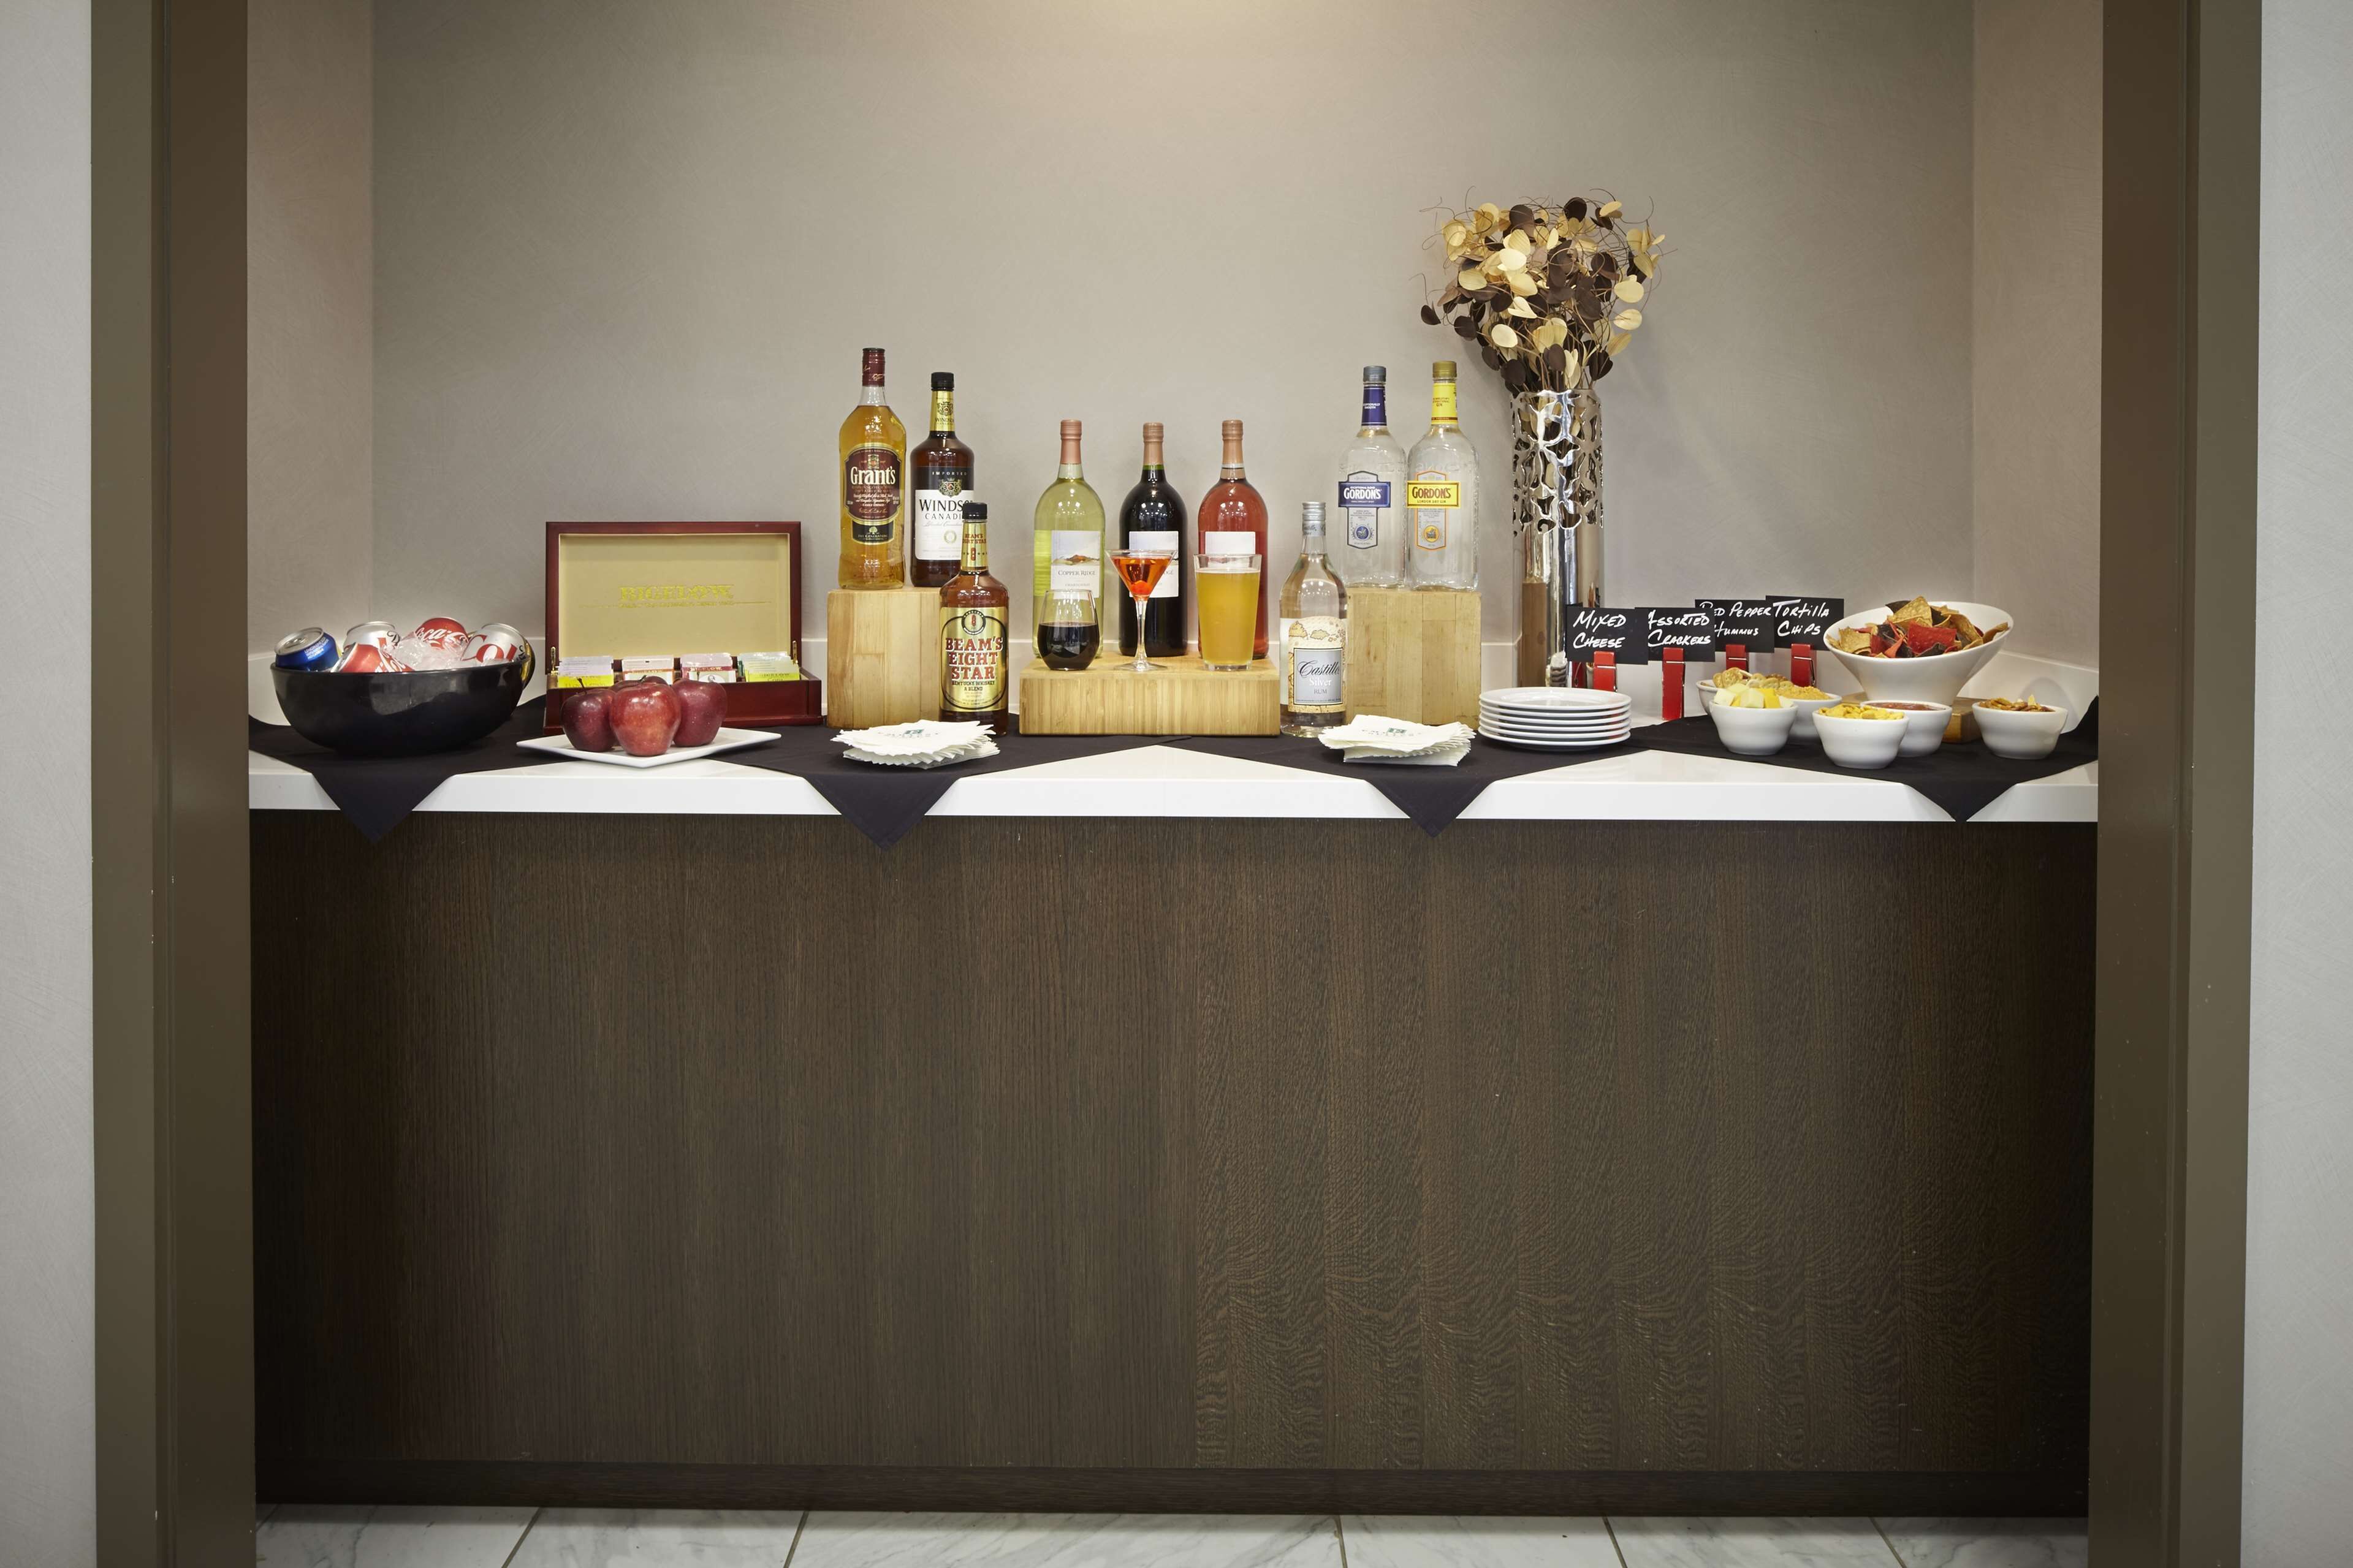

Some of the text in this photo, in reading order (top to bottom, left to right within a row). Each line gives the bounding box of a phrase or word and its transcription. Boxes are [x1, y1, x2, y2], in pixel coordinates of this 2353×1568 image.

[851, 466, 895, 485] Grant's
[1344, 487, 1382, 499] GORDON'S
[1412, 487, 1451, 499] GORDON'S
[919, 499, 973, 512] WINDS
[1573, 610, 1627, 632] MIXED
[1648, 609, 1710, 631] ASSORTED
[946, 636, 1003, 651] BEAM'S
[1573, 632, 1625, 649] CHEESE
[1648, 629, 1711, 648] CRACKERS
[948, 652, 998, 665] EIGHT
[951, 667, 996, 680] STAR
[1297, 660, 1340, 678] Castillo
[1309, 677, 1332, 686] Silver
